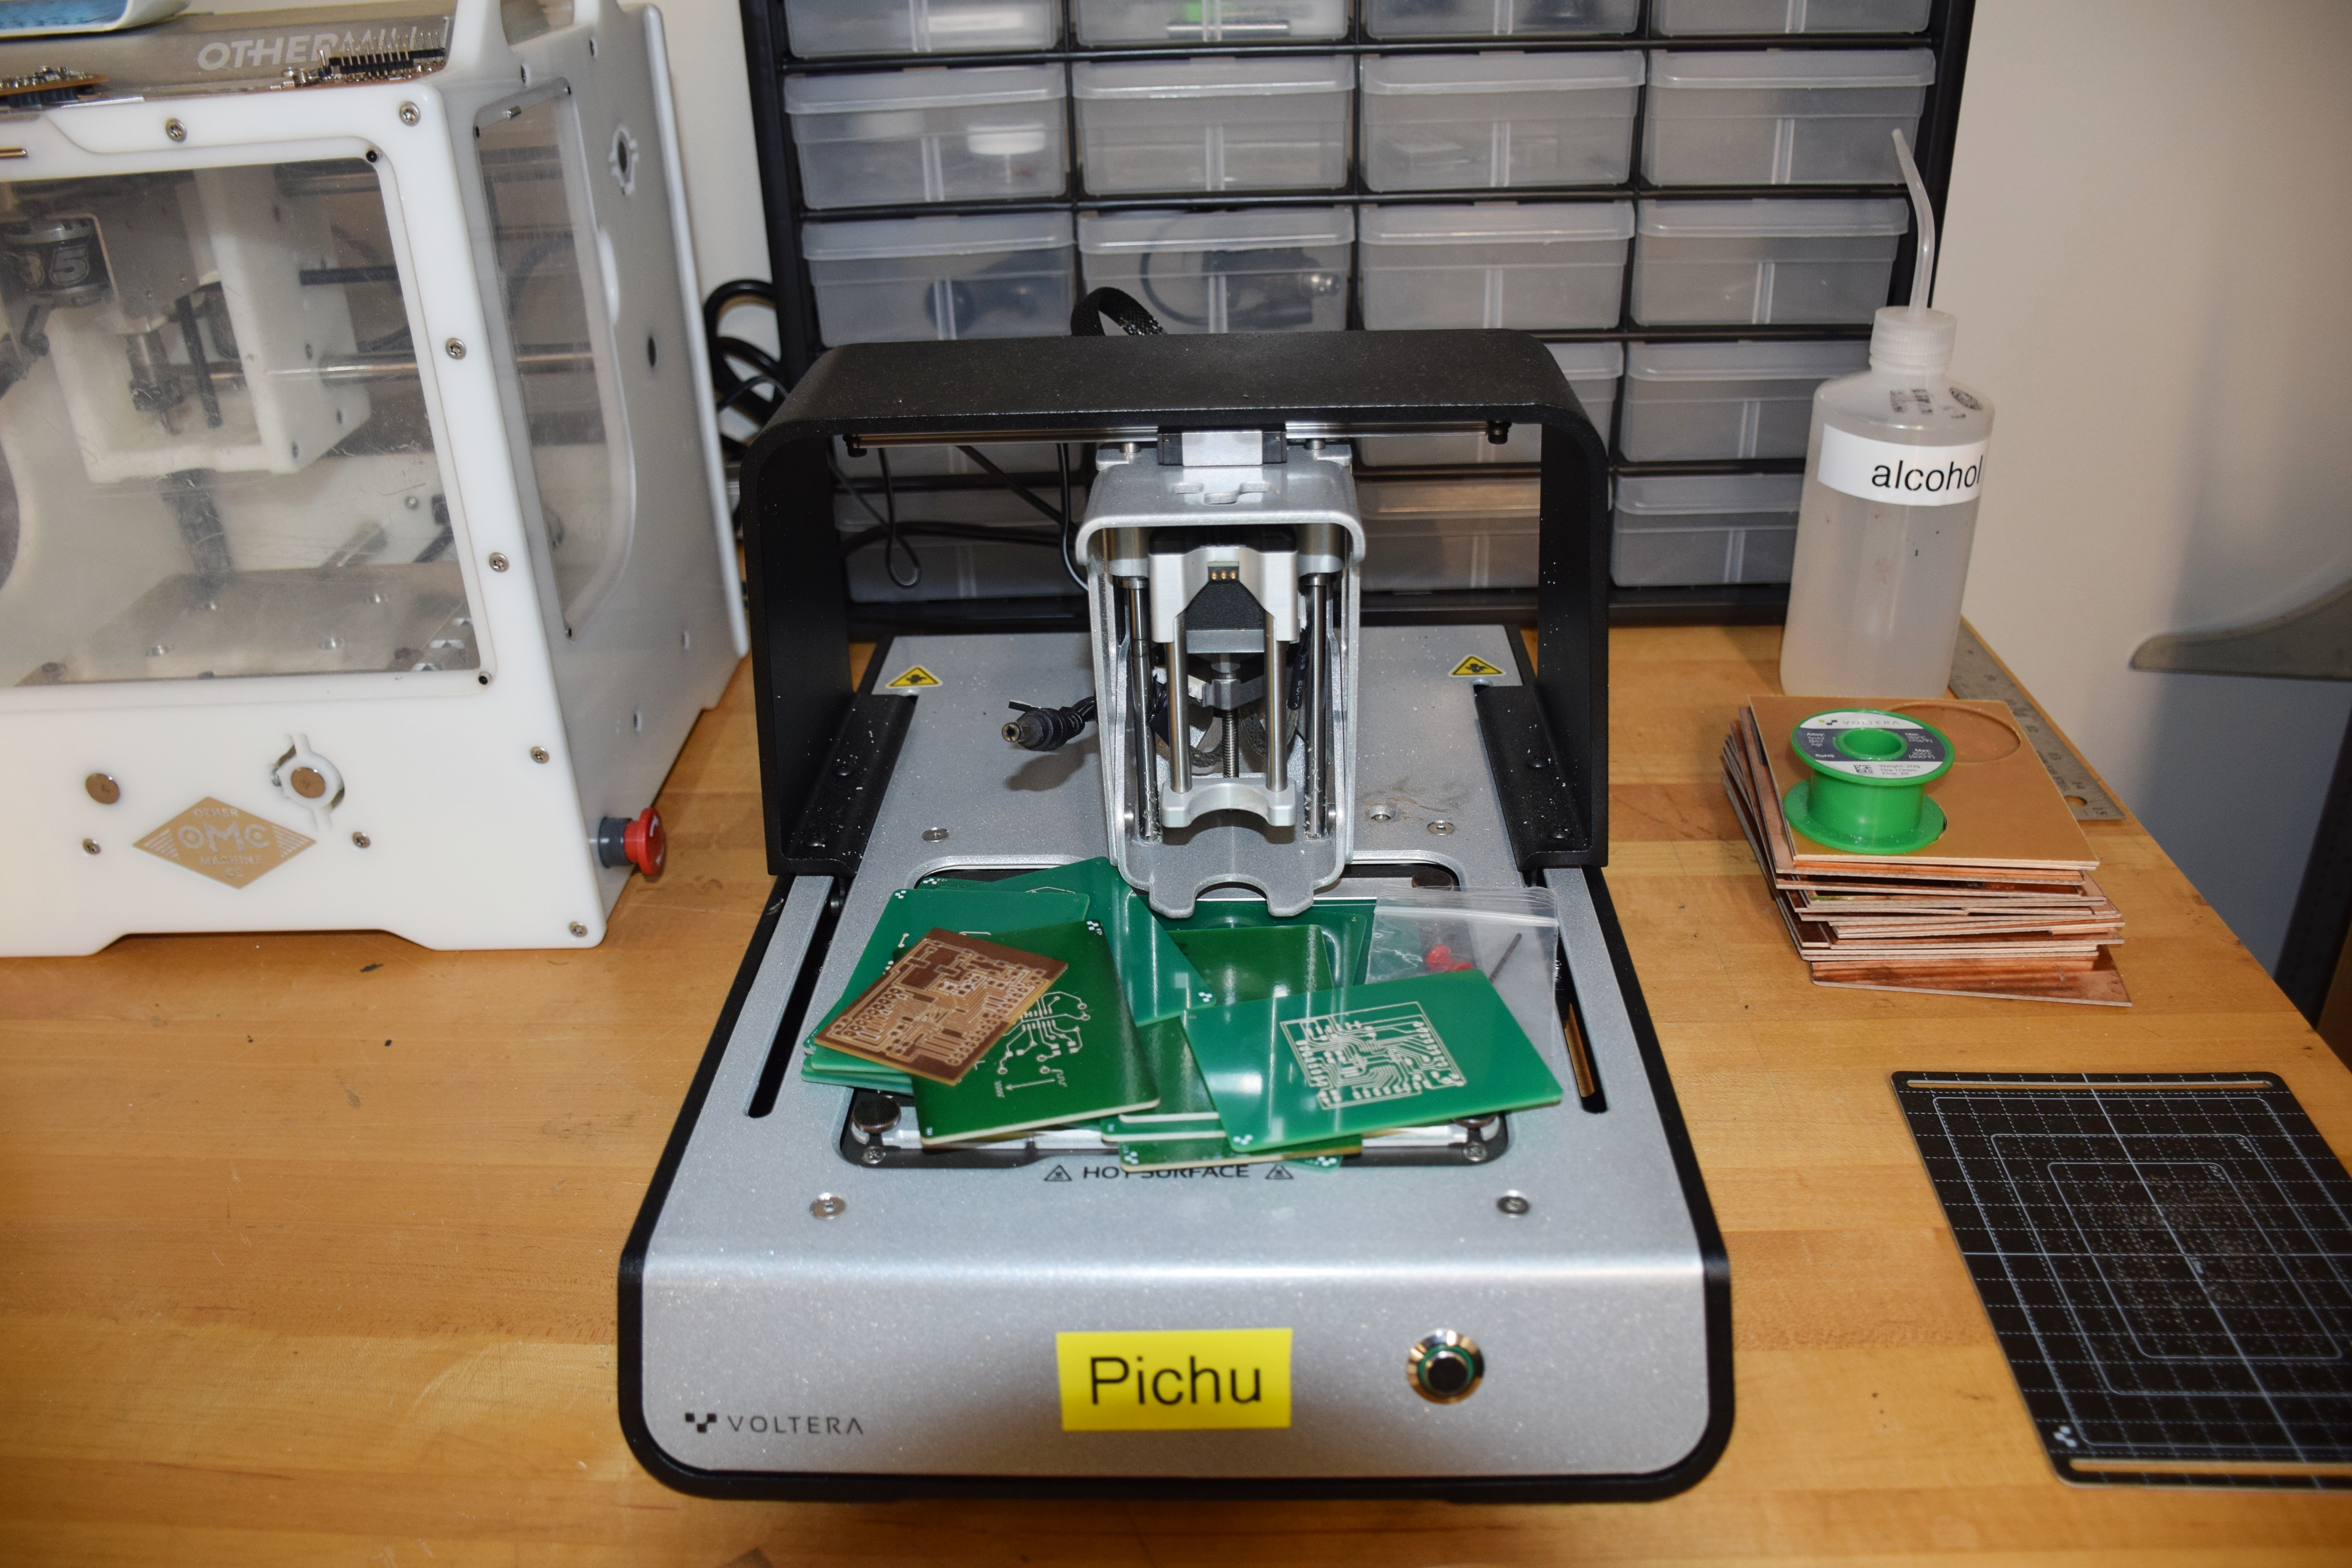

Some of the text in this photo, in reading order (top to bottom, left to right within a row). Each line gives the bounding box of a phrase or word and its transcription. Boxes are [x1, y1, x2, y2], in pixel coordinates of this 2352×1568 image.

[1872, 455, 1983, 492] alcohol
[1294, 680, 1303, 708] K-102
[193, 808, 239, 817] OTHER
[178, 821, 270, 853] OMC
[1090, 1355, 1261, 1405] Pichu
[727, 1415, 863, 1435] VOLTERA
